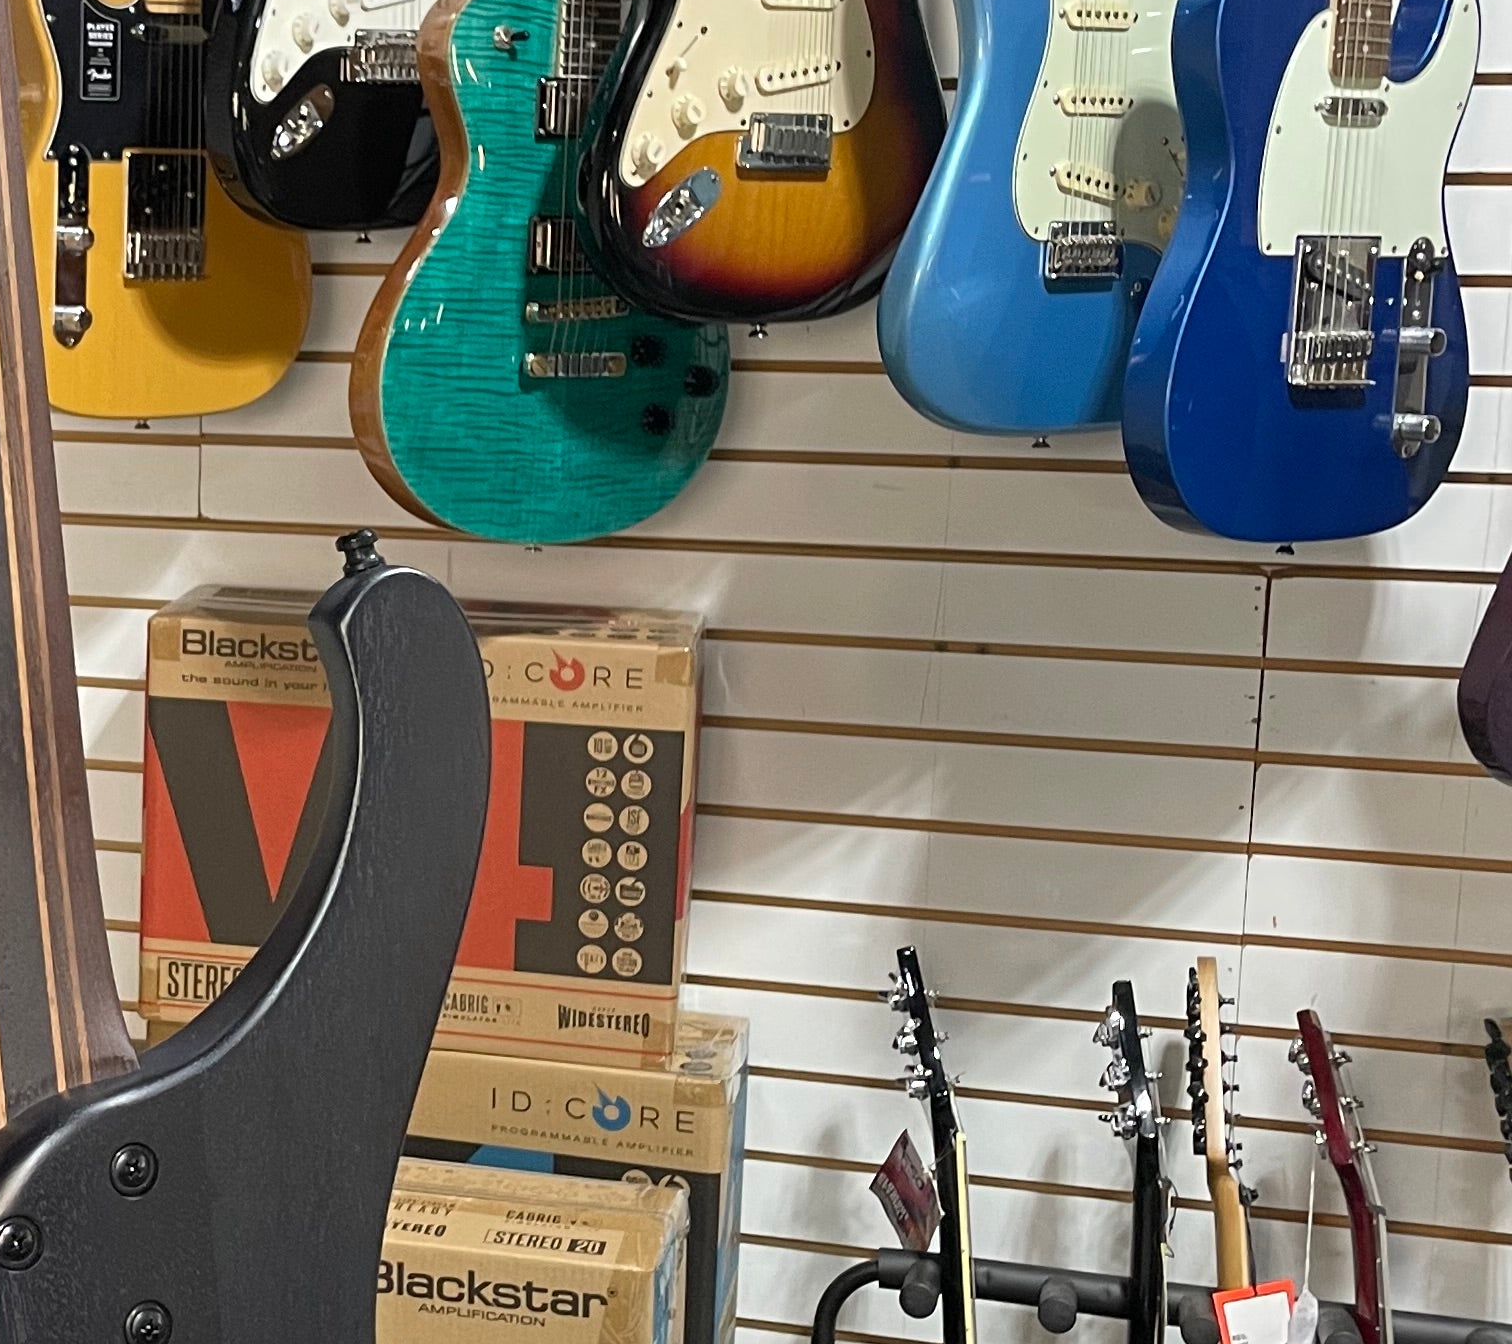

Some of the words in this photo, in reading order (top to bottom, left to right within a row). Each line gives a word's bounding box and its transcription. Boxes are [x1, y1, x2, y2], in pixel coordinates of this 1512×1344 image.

[182, 628, 319, 663] Blackst
[224, 660, 318, 673] AMPLIFICATION
[181, 673, 208, 684] the
[213, 676, 260, 688] sound
[265, 678, 278, 689] in
[284, 680, 318, 691] your
[572, 700, 644, 713] AMPLIFIER
[557, 1003, 651, 1039] WIDESTEREO
[491, 1123, 609, 1147] PROGRAMMABLE
[616, 1140, 694, 1157] AMPLIFIER
[493, 1230, 563, 1251] STEREO
[574, 1238, 602, 1254] 20
[377, 1259, 609, 1319] Blackstar
[418, 1302, 546, 1328] AMPLIFICATION
